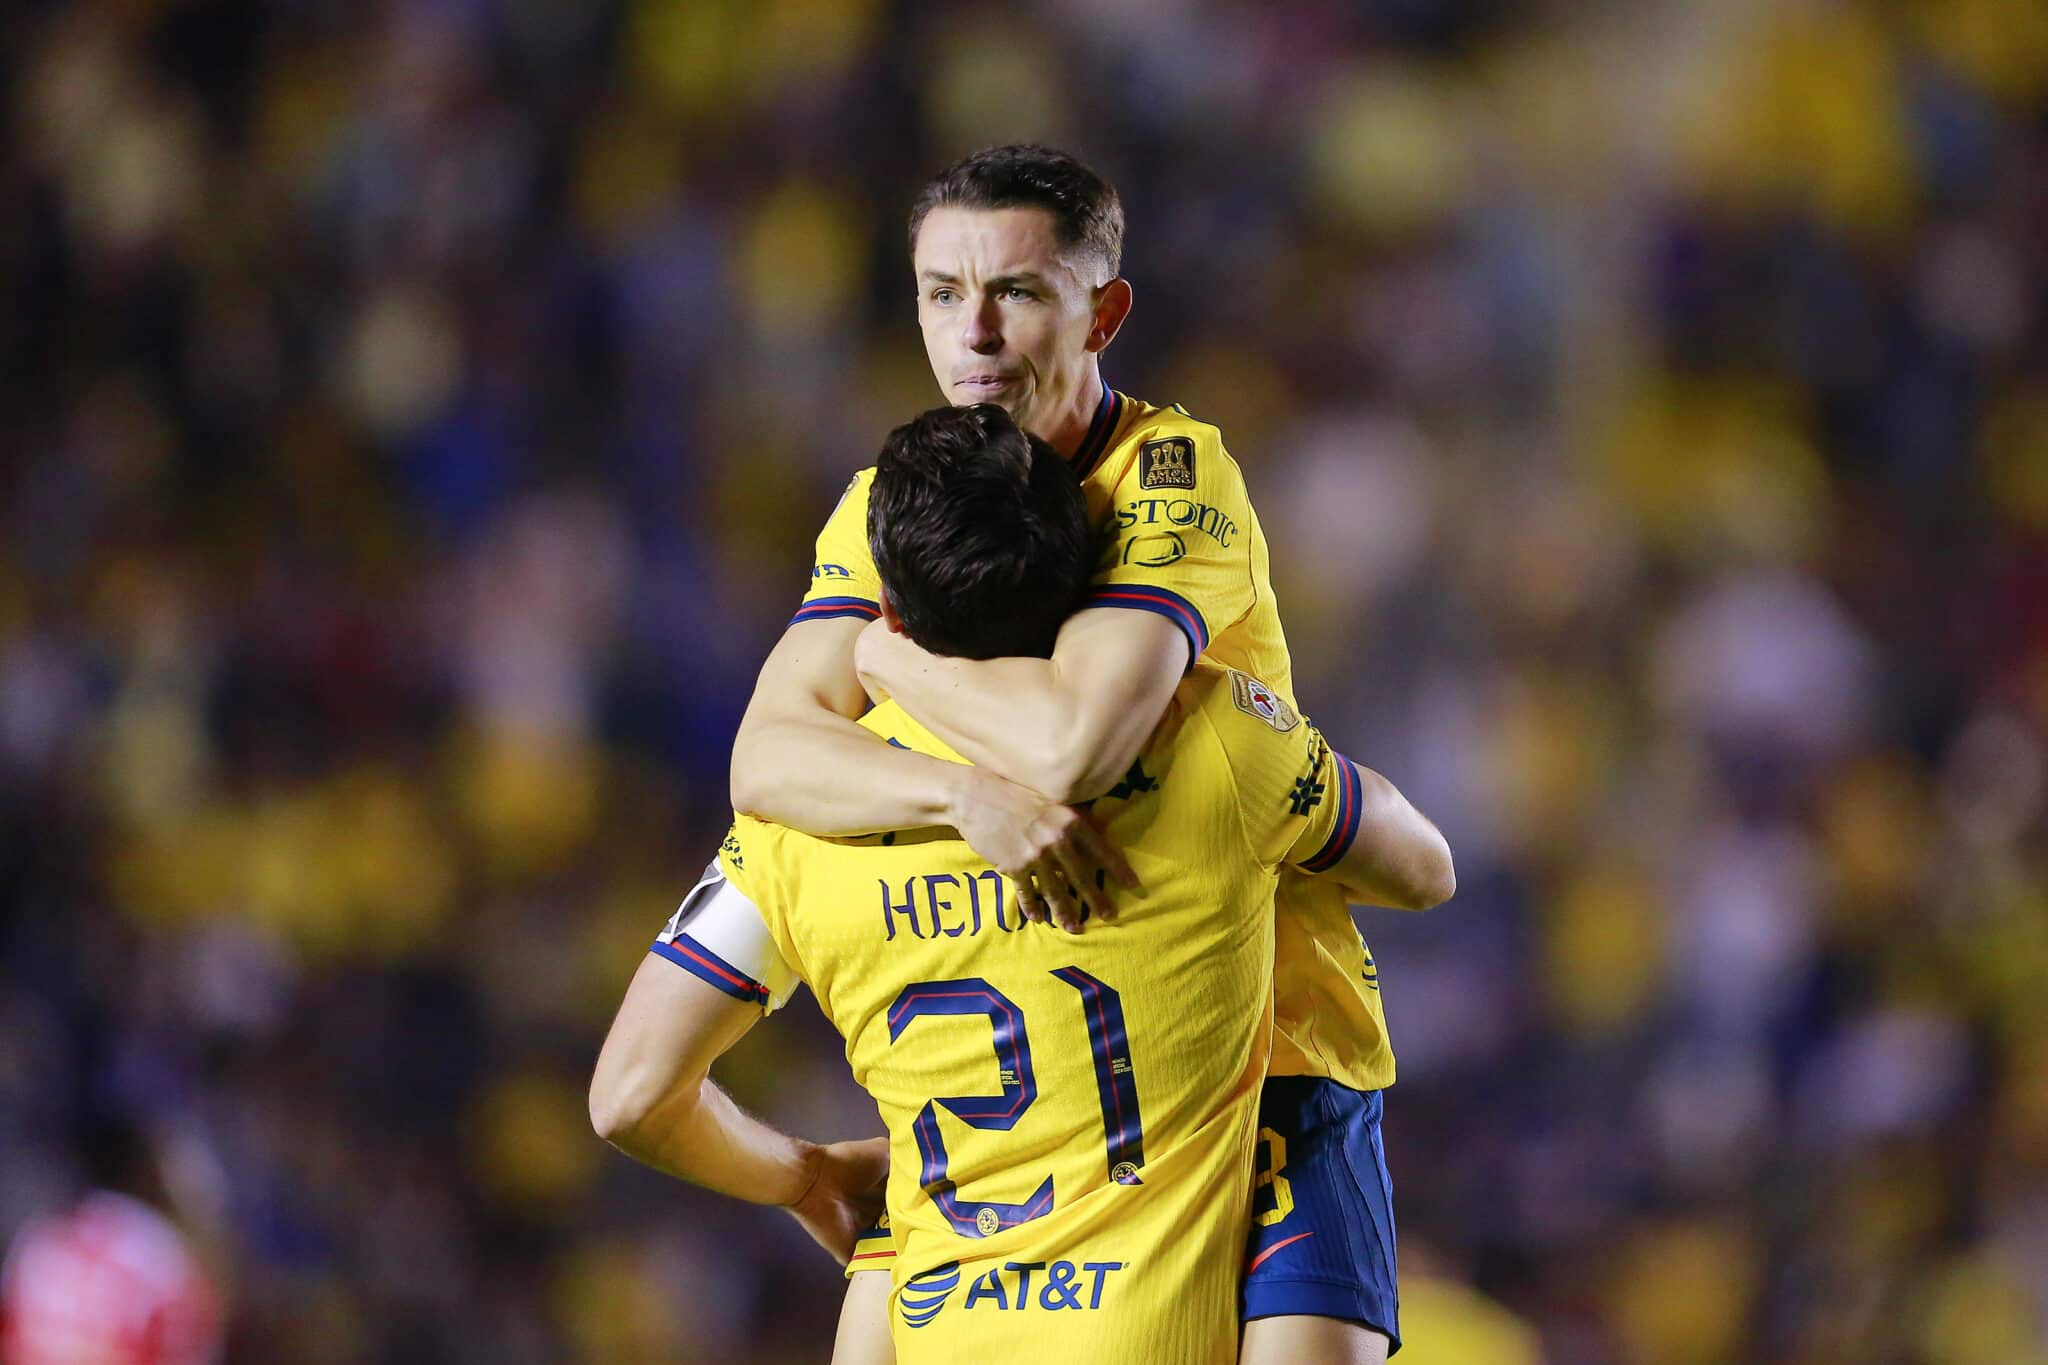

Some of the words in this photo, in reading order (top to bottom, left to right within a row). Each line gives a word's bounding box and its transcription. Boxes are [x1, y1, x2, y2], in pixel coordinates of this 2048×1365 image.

[1117, 499, 1237, 548] STONIC
[878, 869, 1105, 941] HEN
[887, 965, 1144, 1238] 21
[964, 1260, 1122, 1311] AT&T
